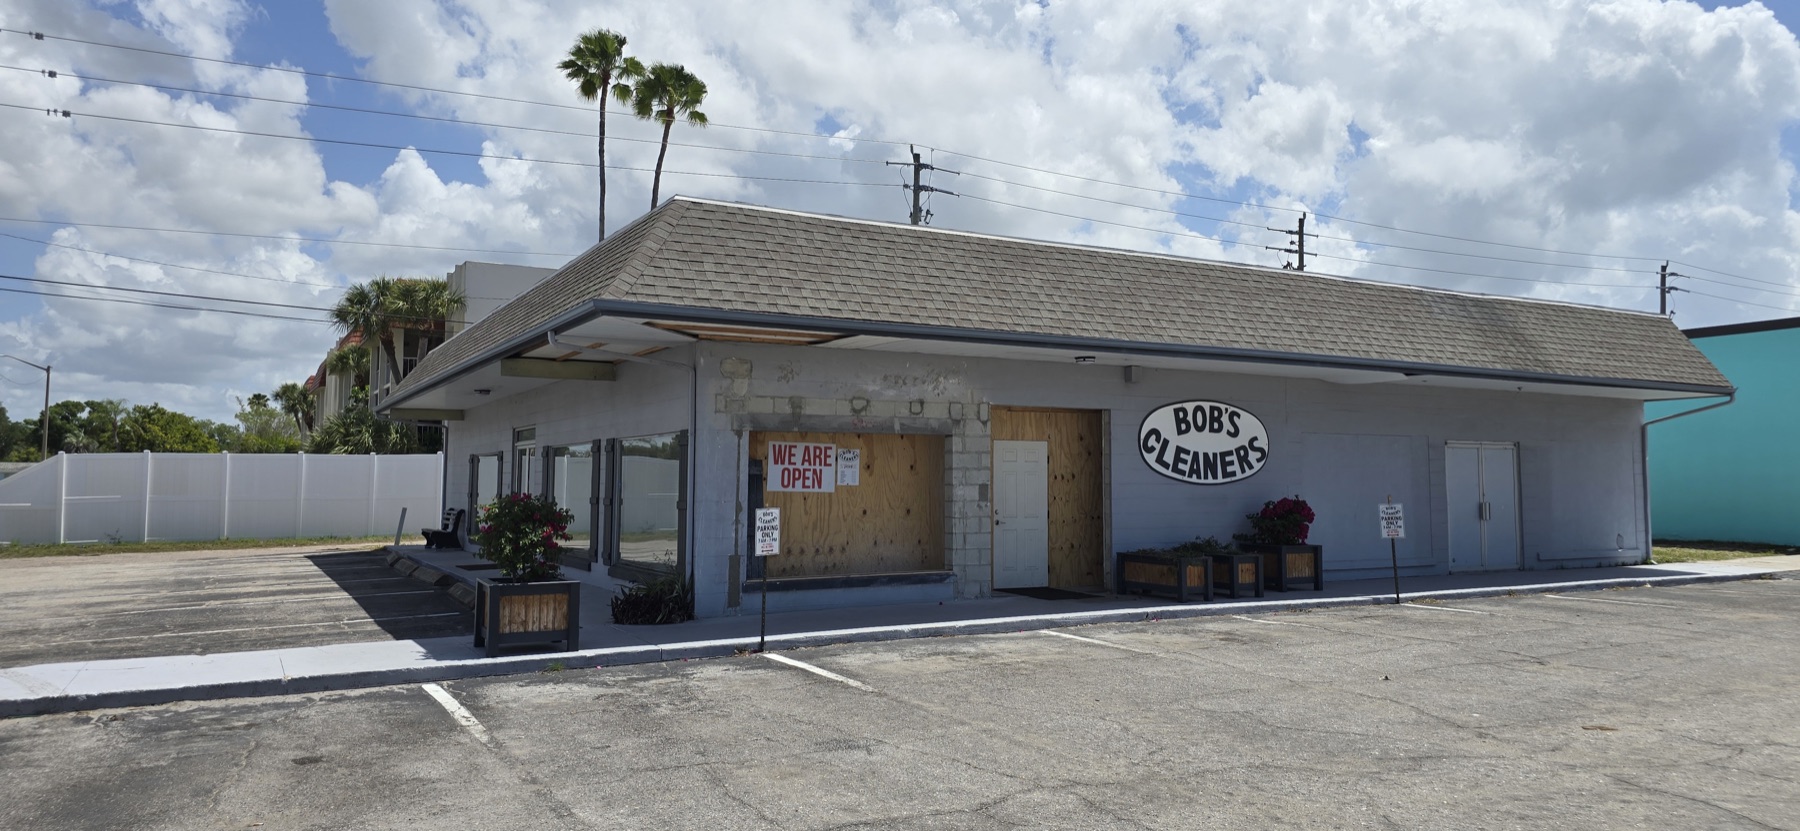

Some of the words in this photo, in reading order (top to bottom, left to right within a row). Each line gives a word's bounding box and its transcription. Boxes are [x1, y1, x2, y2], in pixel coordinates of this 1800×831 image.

[1173, 405, 1241, 438] BOB'S
[772, 444, 797, 466] WE
[801, 445, 832, 467] ARE
[1142, 428, 1267, 480] CLEANERS
[781, 467, 822, 489] OPEN
[757, 524, 779, 532] PARKING
